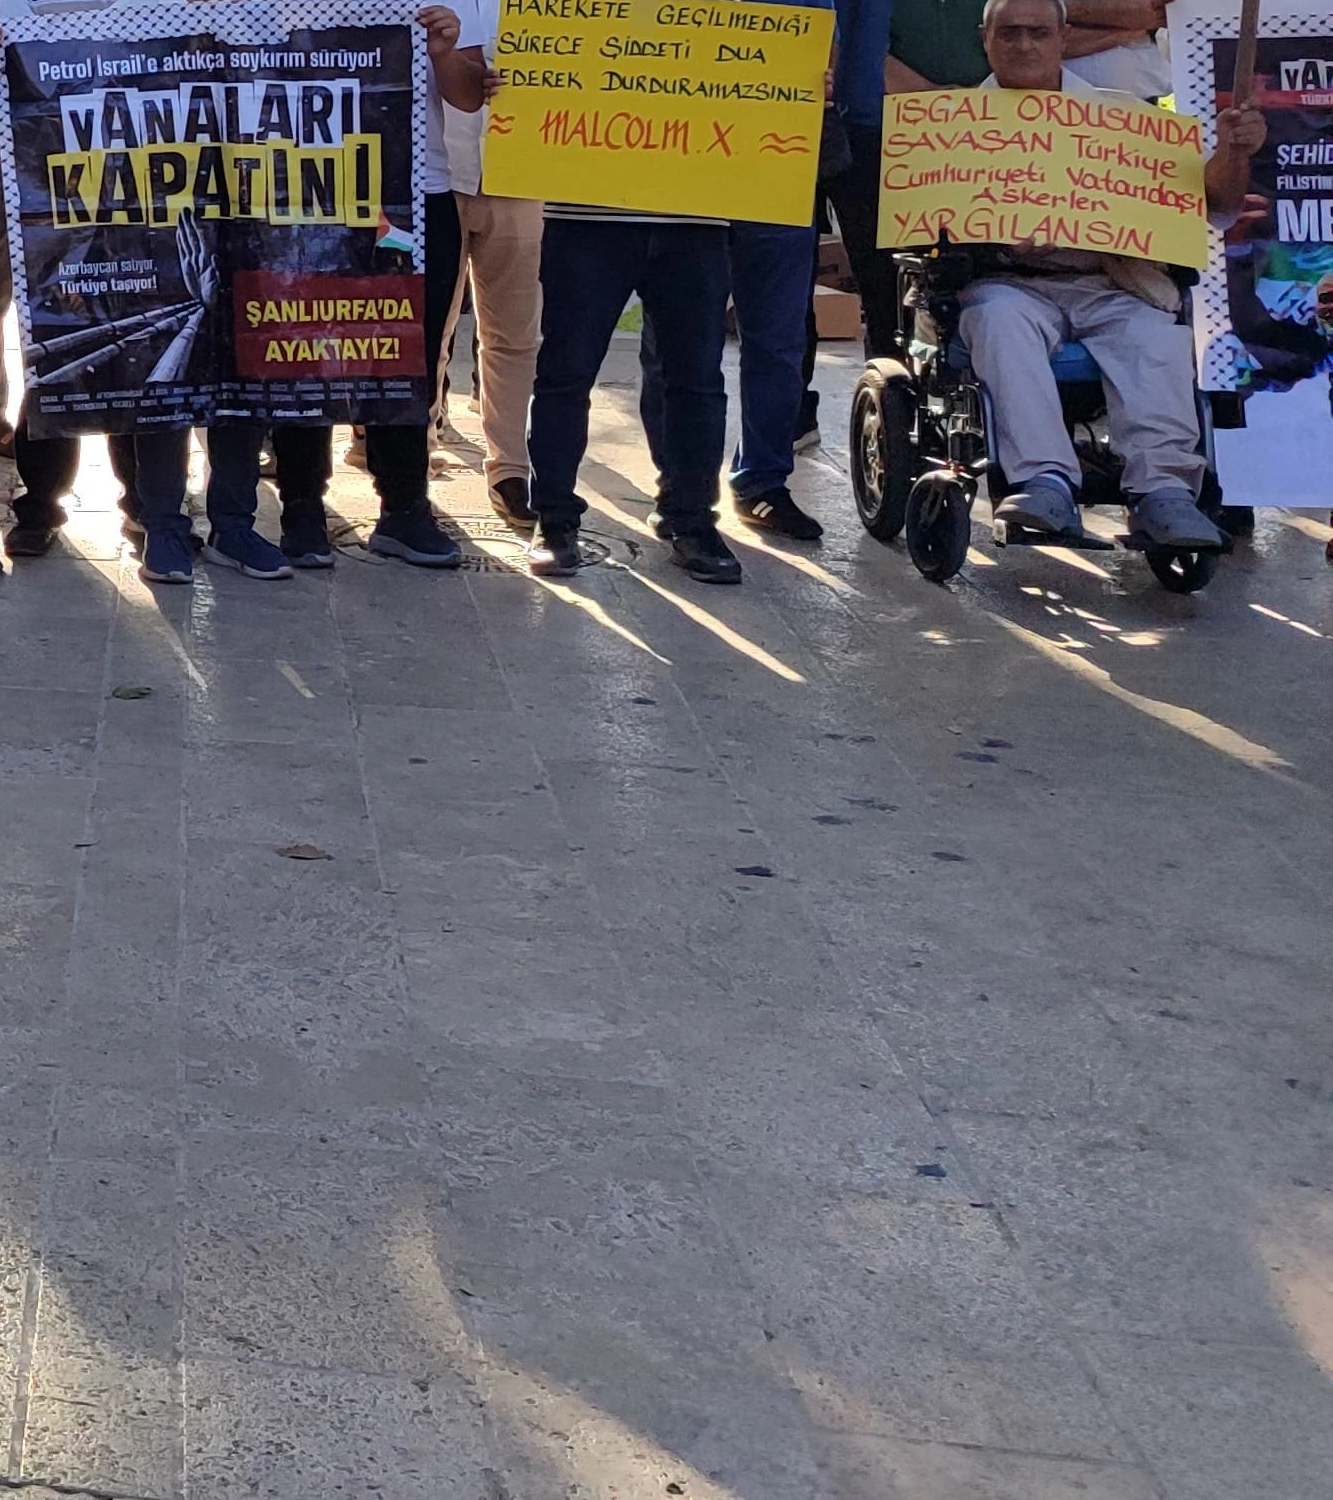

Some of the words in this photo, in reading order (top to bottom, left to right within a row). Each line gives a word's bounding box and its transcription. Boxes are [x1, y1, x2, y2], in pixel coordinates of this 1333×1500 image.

[38, 58, 92, 82] Petrol
[162, 51, 226, 74] aktıkça
[229, 48, 307, 73] soykırım
[309, 47, 382, 73] sürüyor!
[496, 28, 584, 56] SÜRECE
[714, 42, 767, 65] DUA
[498, 67, 584, 91] EDEREK
[599, 70, 819, 104] DURDURAMAZSINIZ
[66, 83, 356, 155] VANALARI
[891, 93, 1000, 128] İŞGAL
[1016, 93, 1204, 156] ORDUSUNDA
[883, 130, 1053, 159] SAVAŞAN
[1069, 132, 1179, 180] Türkiye
[50, 142, 371, 225] KAPATIN!
[883, 160, 1047, 191] Cumhuriyeti
[893, 207, 1155, 256] YARGILANSIN
[57, 260, 119, 278] Azerbaycan
[59, 278, 108, 296] Türkiye
[111, 274, 158, 294] taşıyor!
[264, 336, 401, 363] AYAKTAYIZ!
